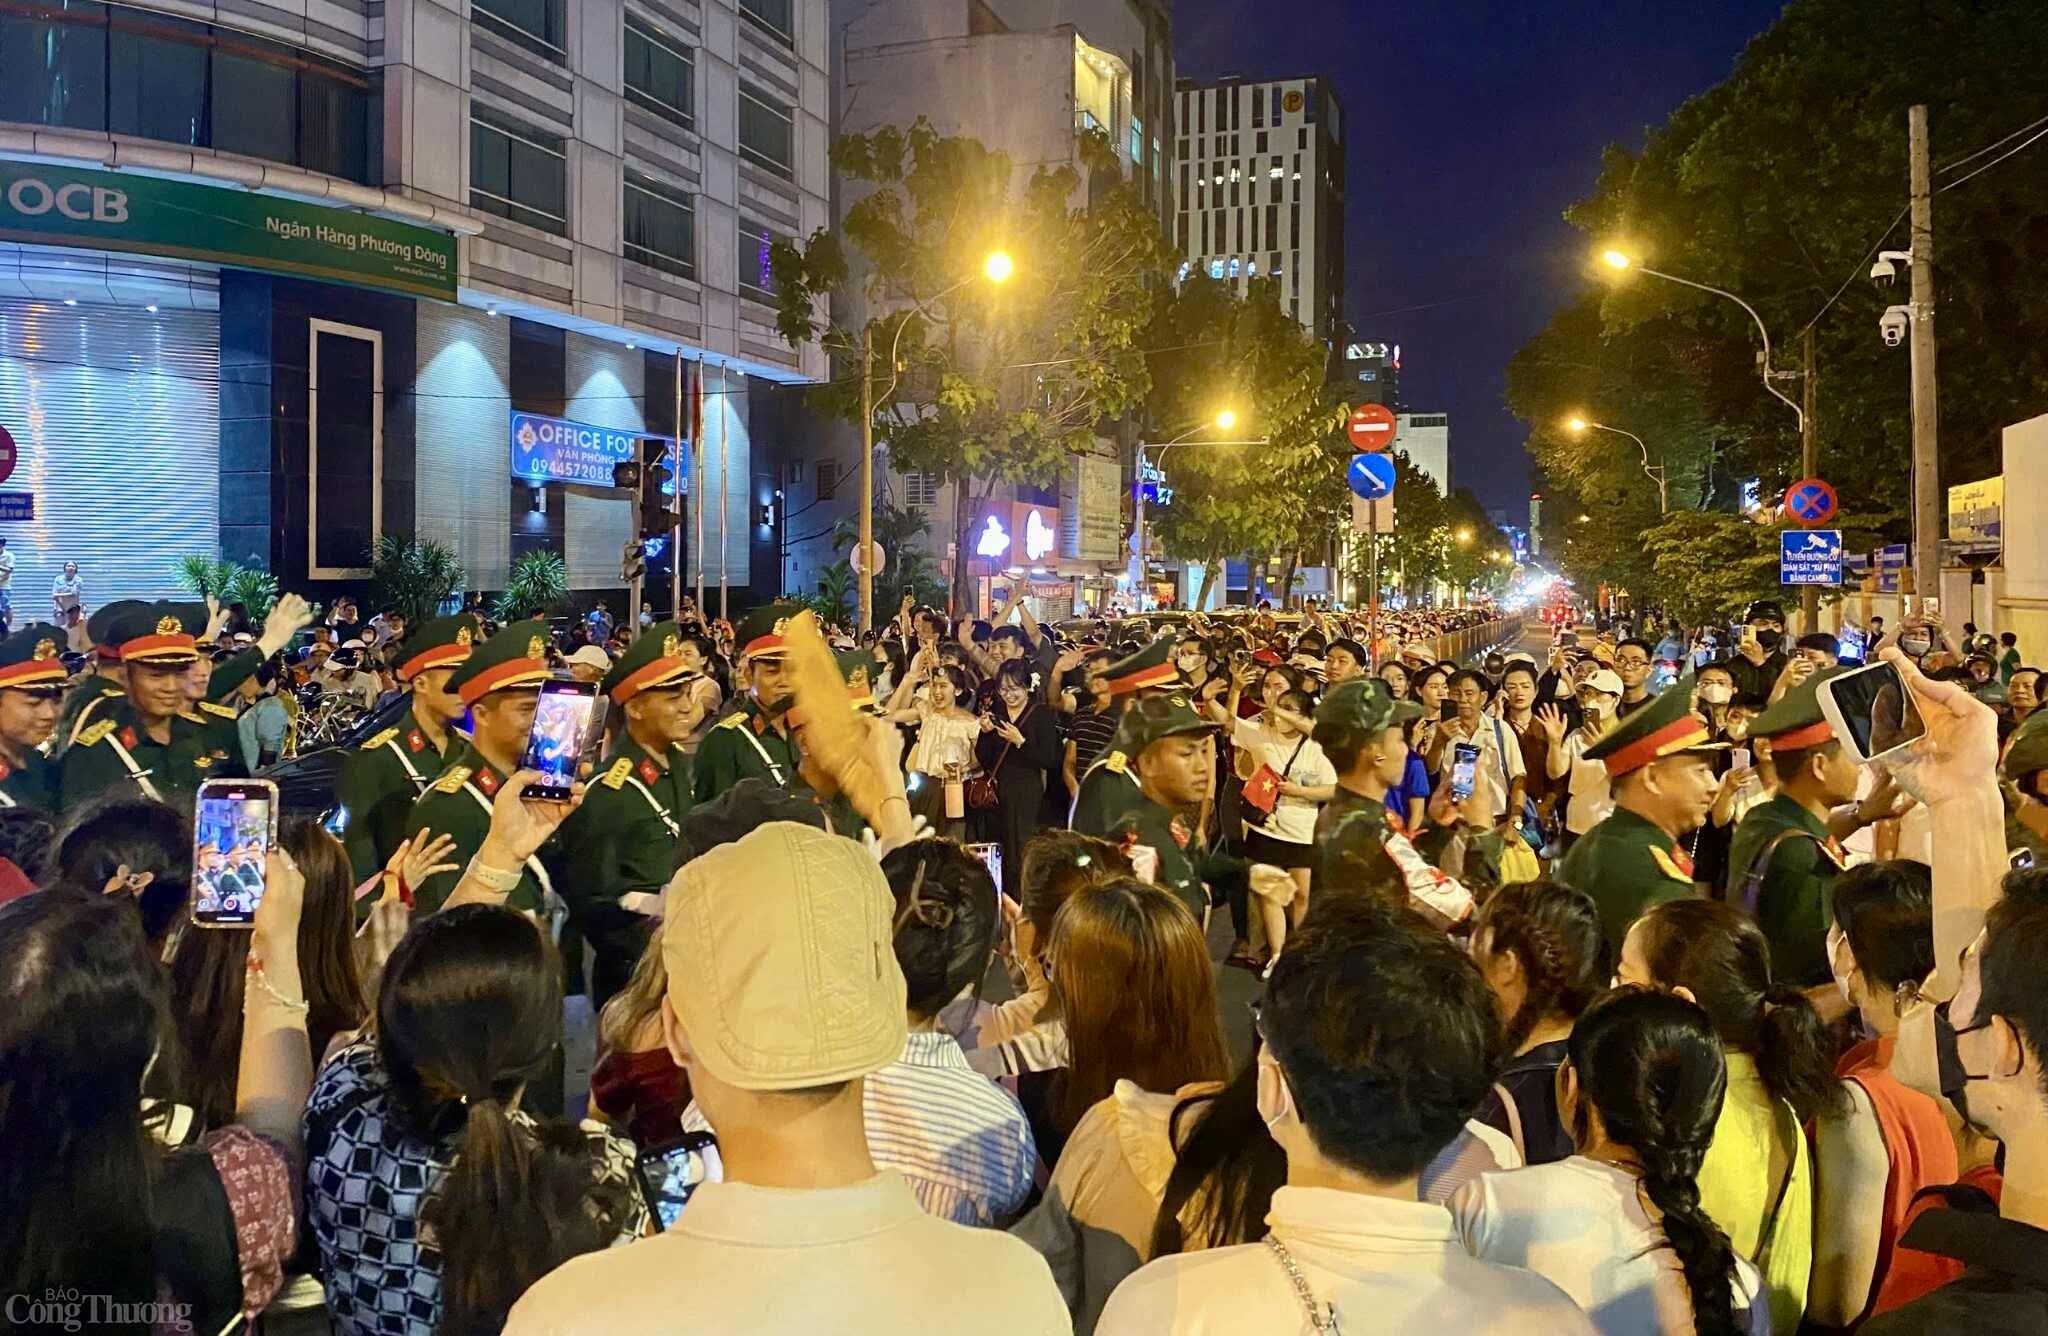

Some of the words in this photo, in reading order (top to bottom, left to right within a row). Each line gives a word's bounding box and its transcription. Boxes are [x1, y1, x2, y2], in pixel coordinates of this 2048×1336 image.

[7, 178, 129, 223] OCB
[265, 216, 310, 240] Ngân
[316, 224, 356, 250] Hàng
[360, 234, 411, 261] Phương
[414, 245, 447, 269] Đông
[539, 423, 600, 451] OFFICE
[531, 457, 613, 481] 0944572088
